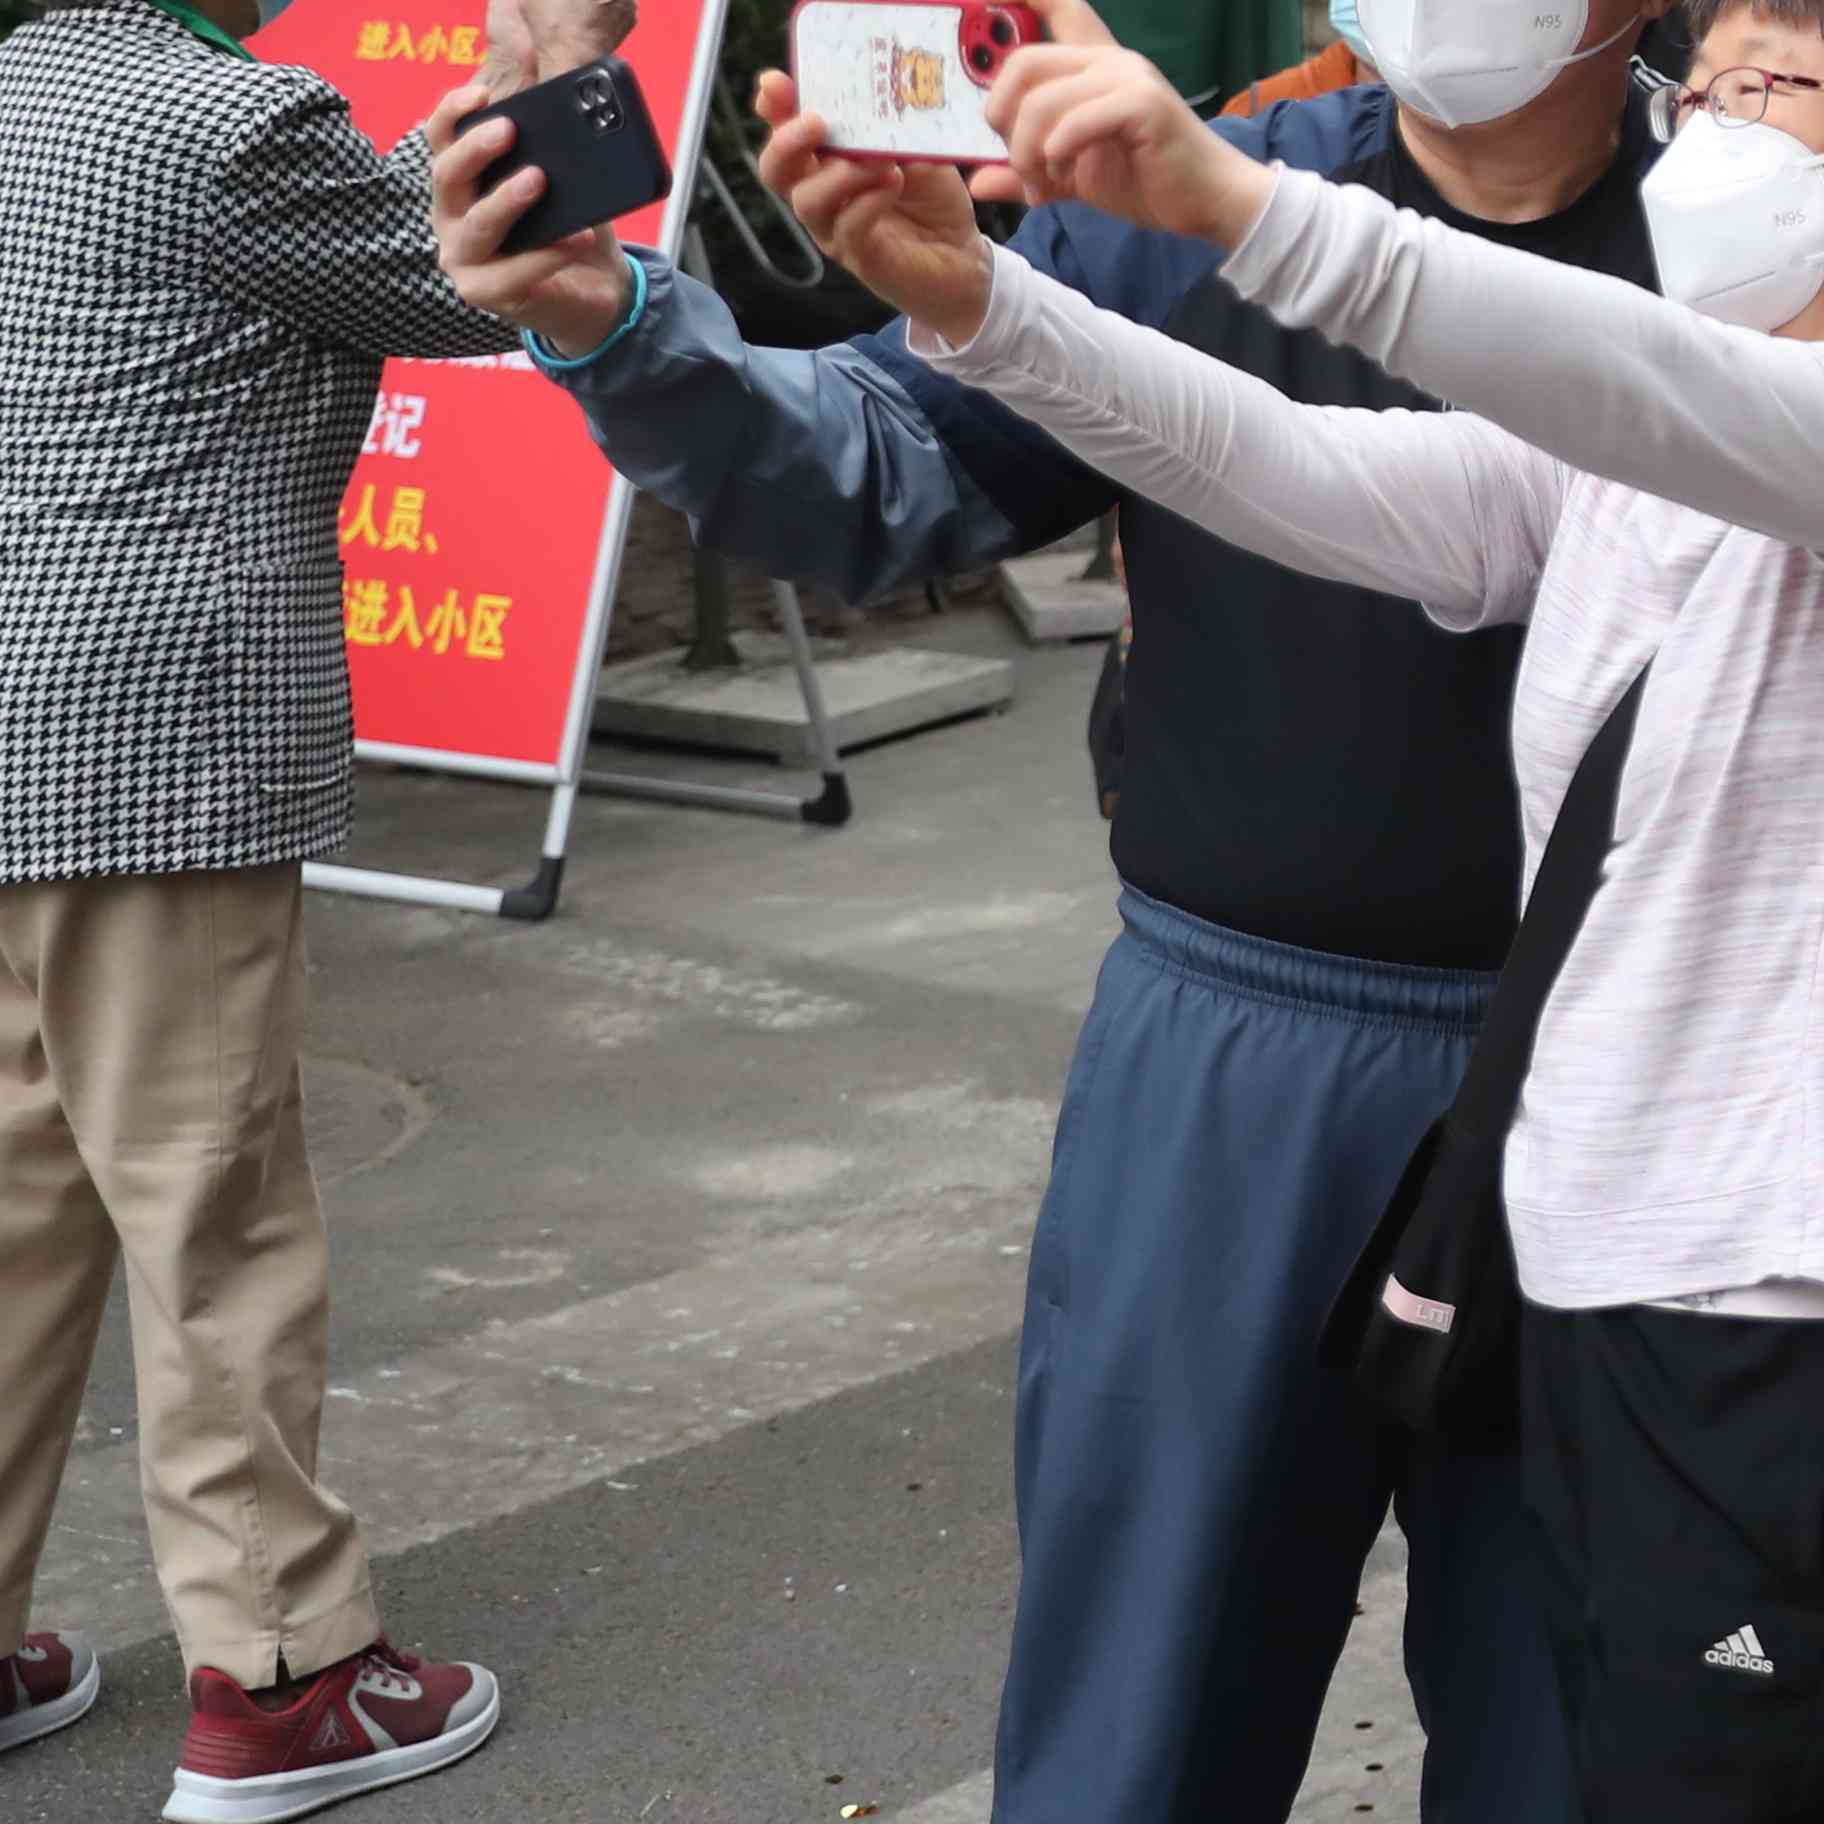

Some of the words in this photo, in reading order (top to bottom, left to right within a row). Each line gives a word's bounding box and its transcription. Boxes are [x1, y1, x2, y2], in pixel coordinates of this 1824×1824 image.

[1535, 14, 1562, 29] N95
[1773, 208, 1807, 227] N95
[337, 484, 438, 555] 人员、
[342, 579, 512, 660] 进入小区
[1705, 1649, 1774, 1673] adidas
